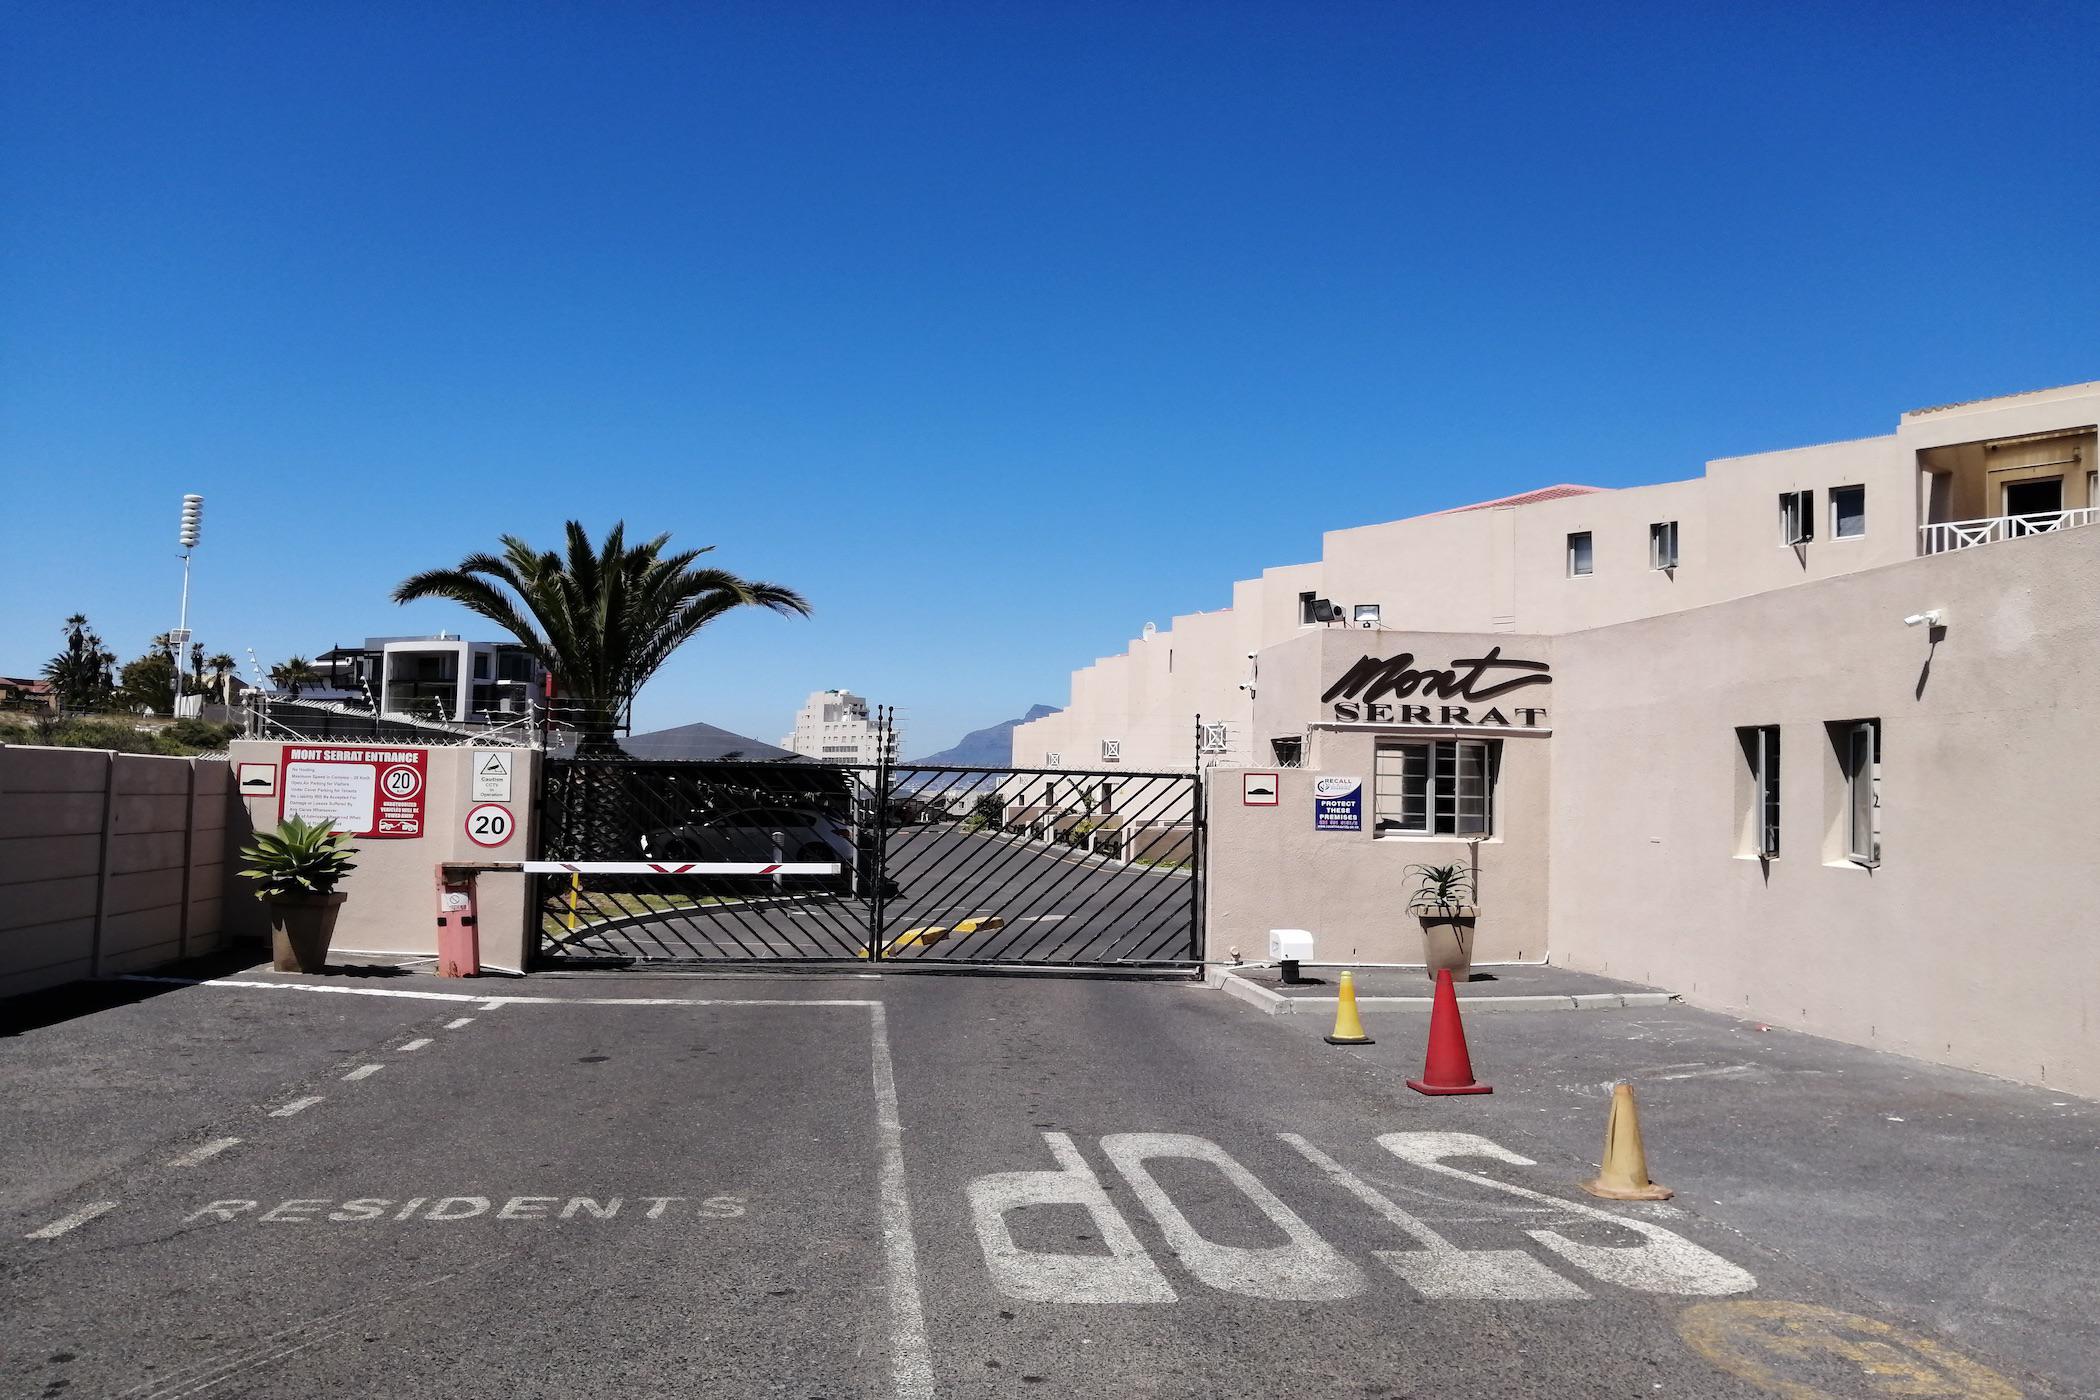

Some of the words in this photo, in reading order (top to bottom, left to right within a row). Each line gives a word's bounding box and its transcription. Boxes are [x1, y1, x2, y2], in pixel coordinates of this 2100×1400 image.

[1321, 646, 1553, 703] Mont
[1334, 701, 1549, 727] SERRAT
[291, 749, 322, 760] MONT
[323, 750, 363, 762] SERRAT
[365, 752, 419, 763] ENTRANCE
[392, 772, 410, 789] 20
[475, 815, 505, 835] 20
[1319, 813, 1358, 821] PREMISES
[182, 1195, 748, 1223] RESIDENTS
[965, 1131, 1758, 1305] STOP
